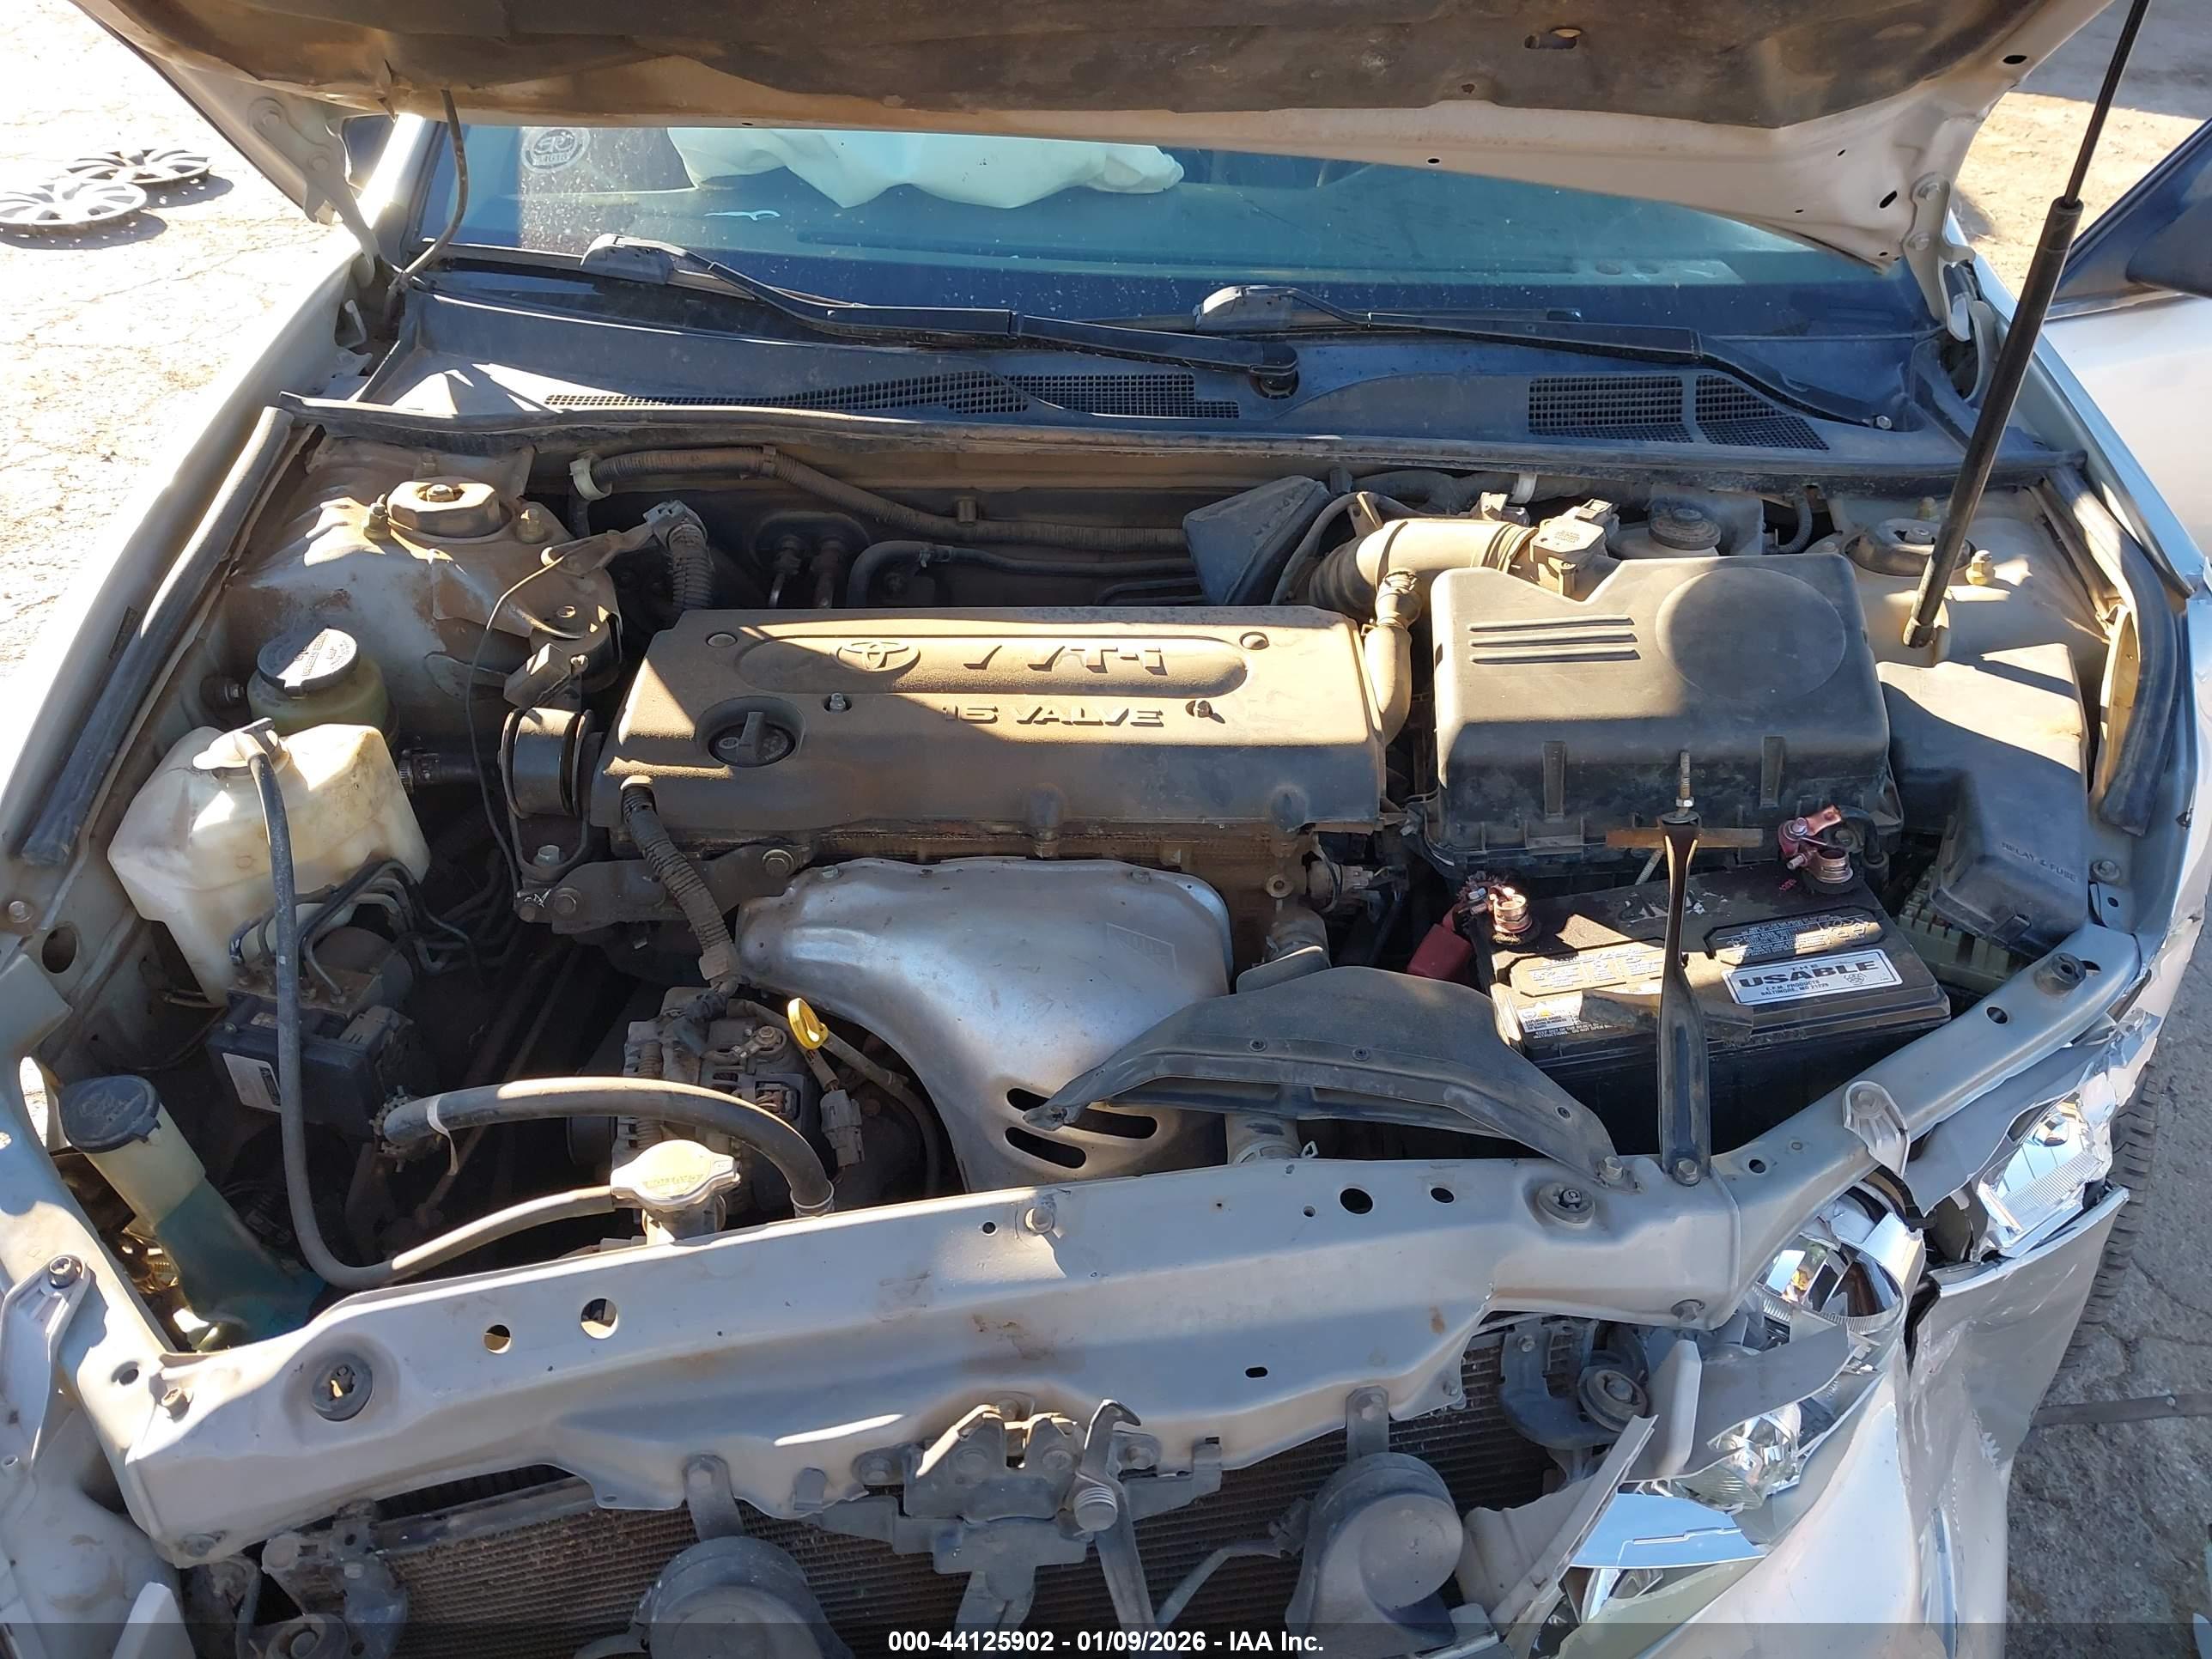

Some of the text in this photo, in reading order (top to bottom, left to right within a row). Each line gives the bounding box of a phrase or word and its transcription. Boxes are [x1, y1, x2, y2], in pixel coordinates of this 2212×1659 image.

[940, 703, 1164, 728] 16 VALVE
[2000, 842, 2038, 862] RELAY
[2049, 863, 2079, 884] FUSE
[1739, 960, 1879, 988] USABLE
[1787, 980, 1820, 988] PRODUCTS
